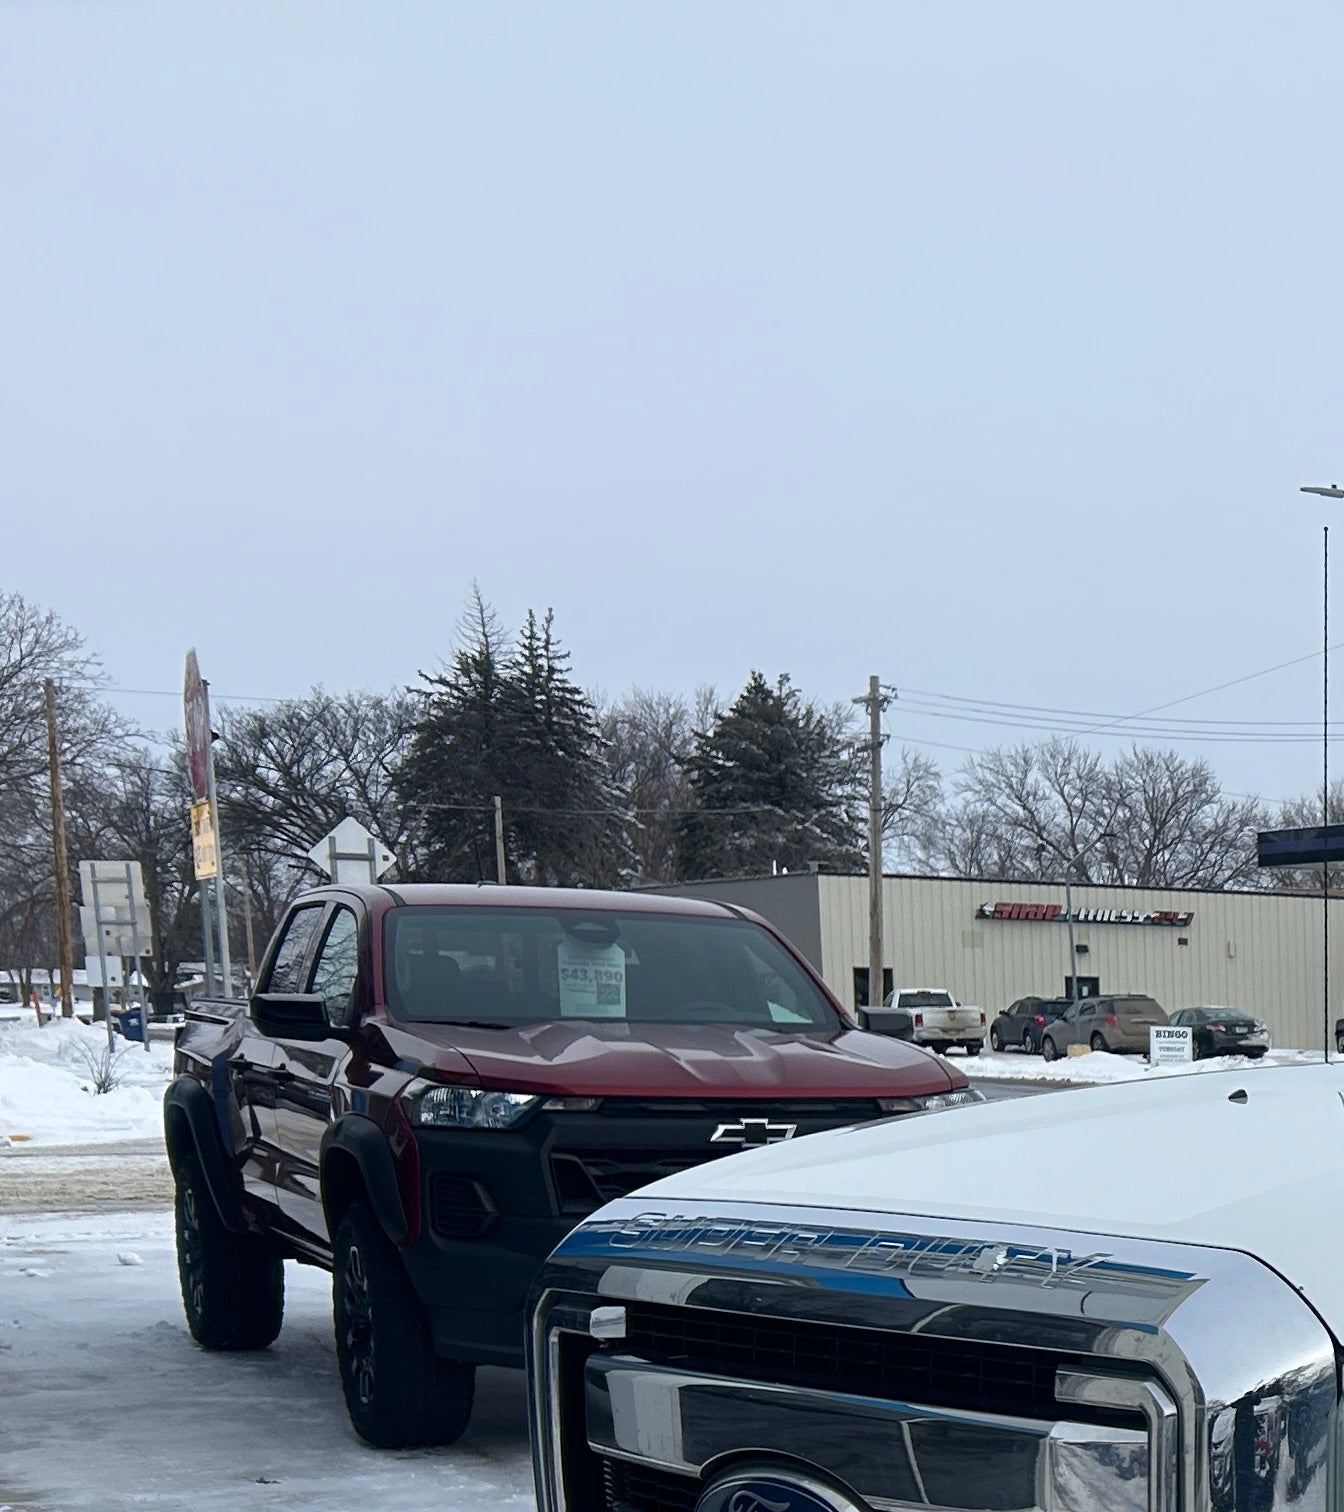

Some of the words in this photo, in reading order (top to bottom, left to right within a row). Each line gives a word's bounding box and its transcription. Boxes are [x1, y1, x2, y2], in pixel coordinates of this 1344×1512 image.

[1155, 1030, 1188, 1039] BINGO
[609, 1212, 834, 1261] SUPER
[843, 1231, 1113, 1289] DUTY
